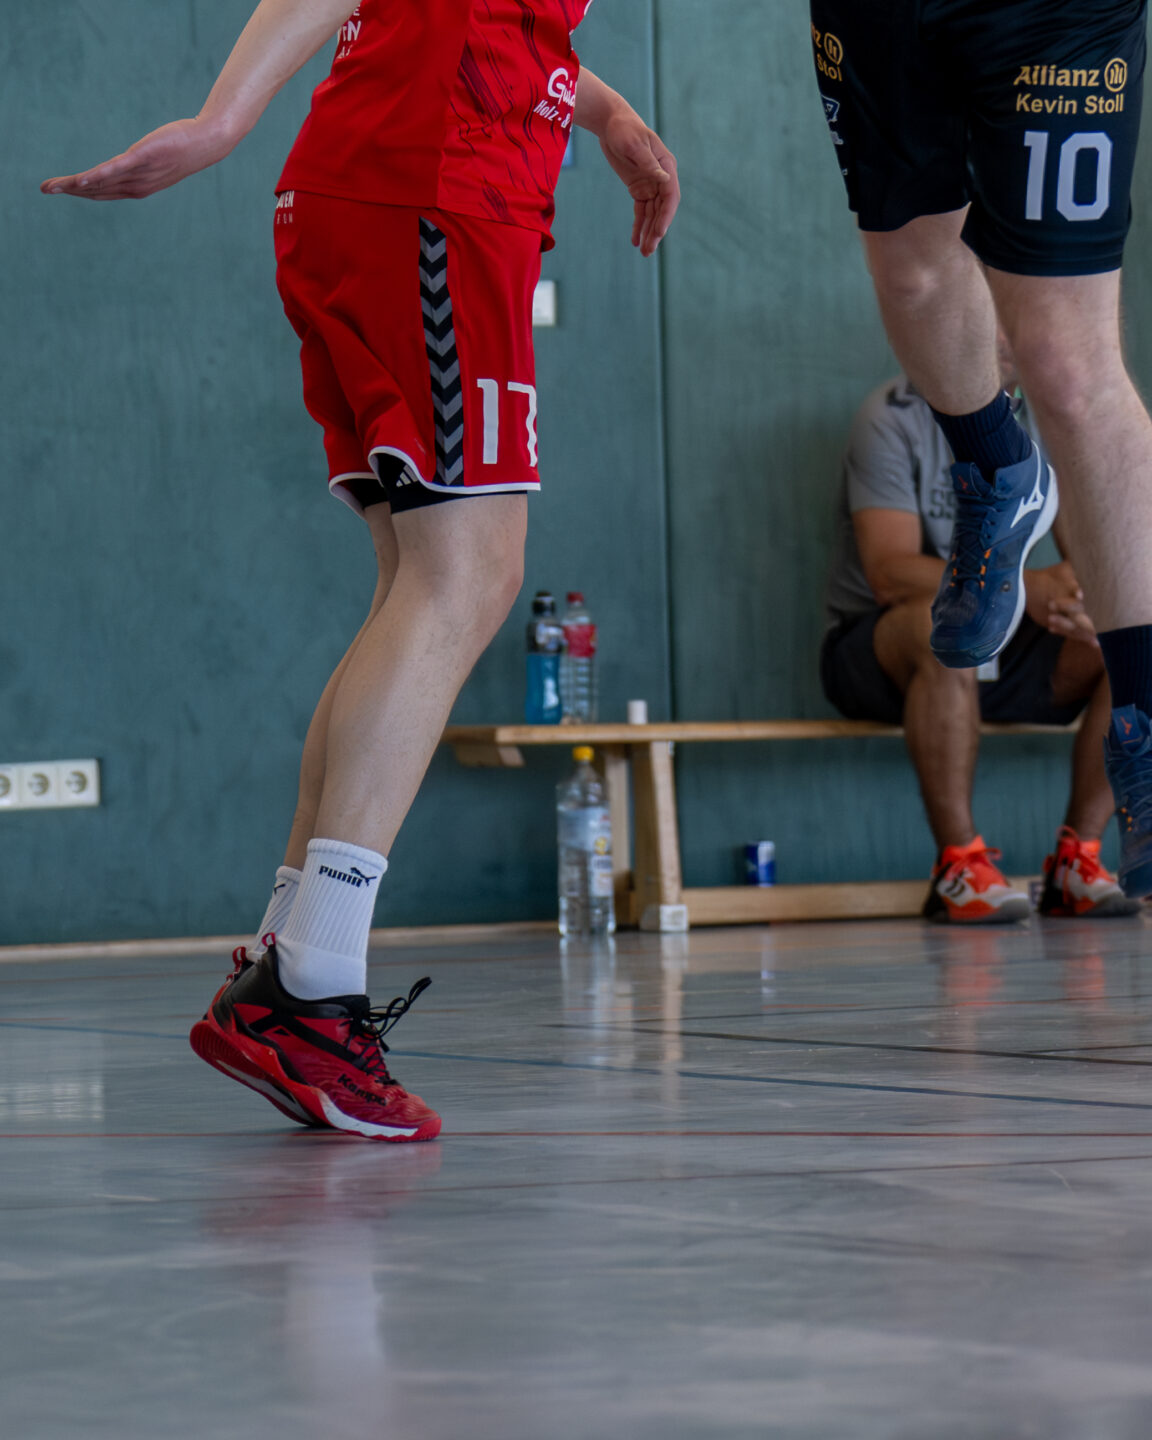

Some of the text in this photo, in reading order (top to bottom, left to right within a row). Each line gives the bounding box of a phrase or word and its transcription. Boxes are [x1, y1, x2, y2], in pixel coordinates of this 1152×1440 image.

[1013, 64, 1100, 87] Allianz
[1015, 93, 1124, 114] Kevin Stoll
[1024, 130, 1113, 222] 10
[477, 378, 538, 467] 17
[319, 865, 362, 888] PUMA
